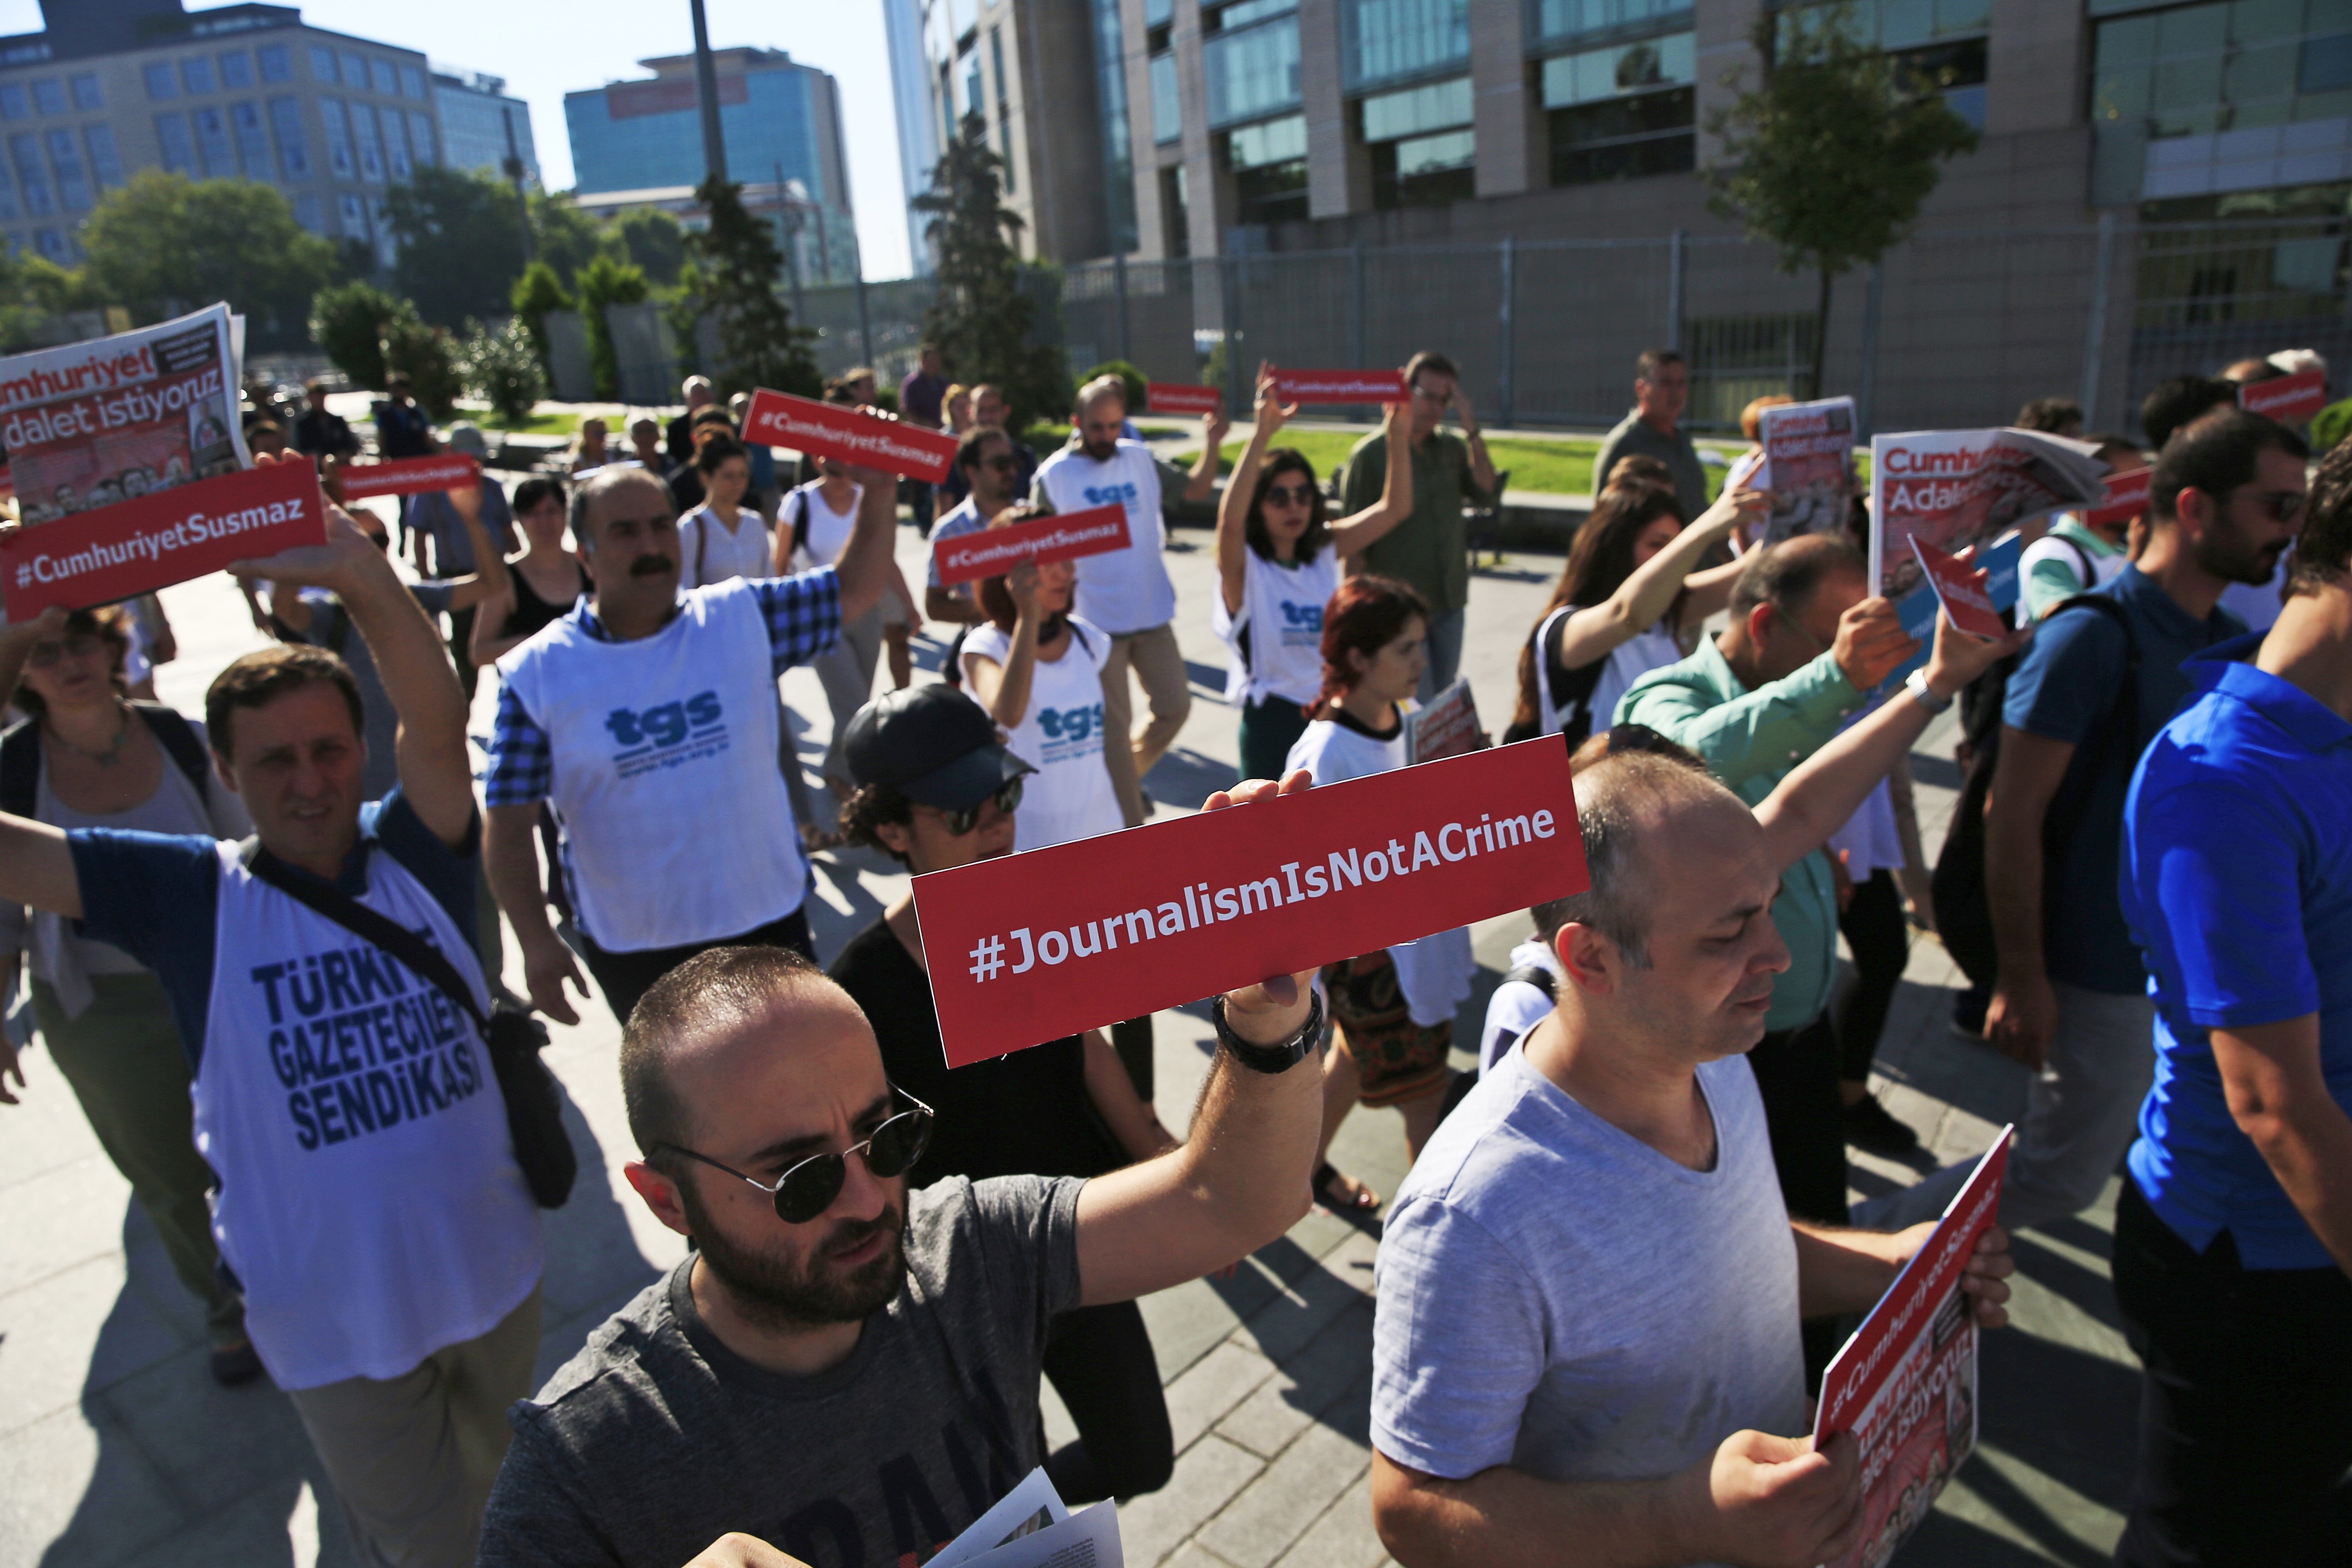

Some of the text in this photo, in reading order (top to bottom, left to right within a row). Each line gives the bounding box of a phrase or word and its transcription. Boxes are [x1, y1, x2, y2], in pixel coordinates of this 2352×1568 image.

[0, 346, 153, 405] mhuriyet
[5, 368, 222, 448] dalet istiyoruz
[758, 411, 944, 468] #CumhuriyetSusmaz
[15, 498, 305, 589] #CumhuriyetSusmaz
[947, 523, 1120, 568] #CumhuriyetSusmaz
[1280, 599, 1324, 632] tg
[605, 689, 722, 748] tgs
[969, 809, 1555, 983] #JournalismIsNotACrime
